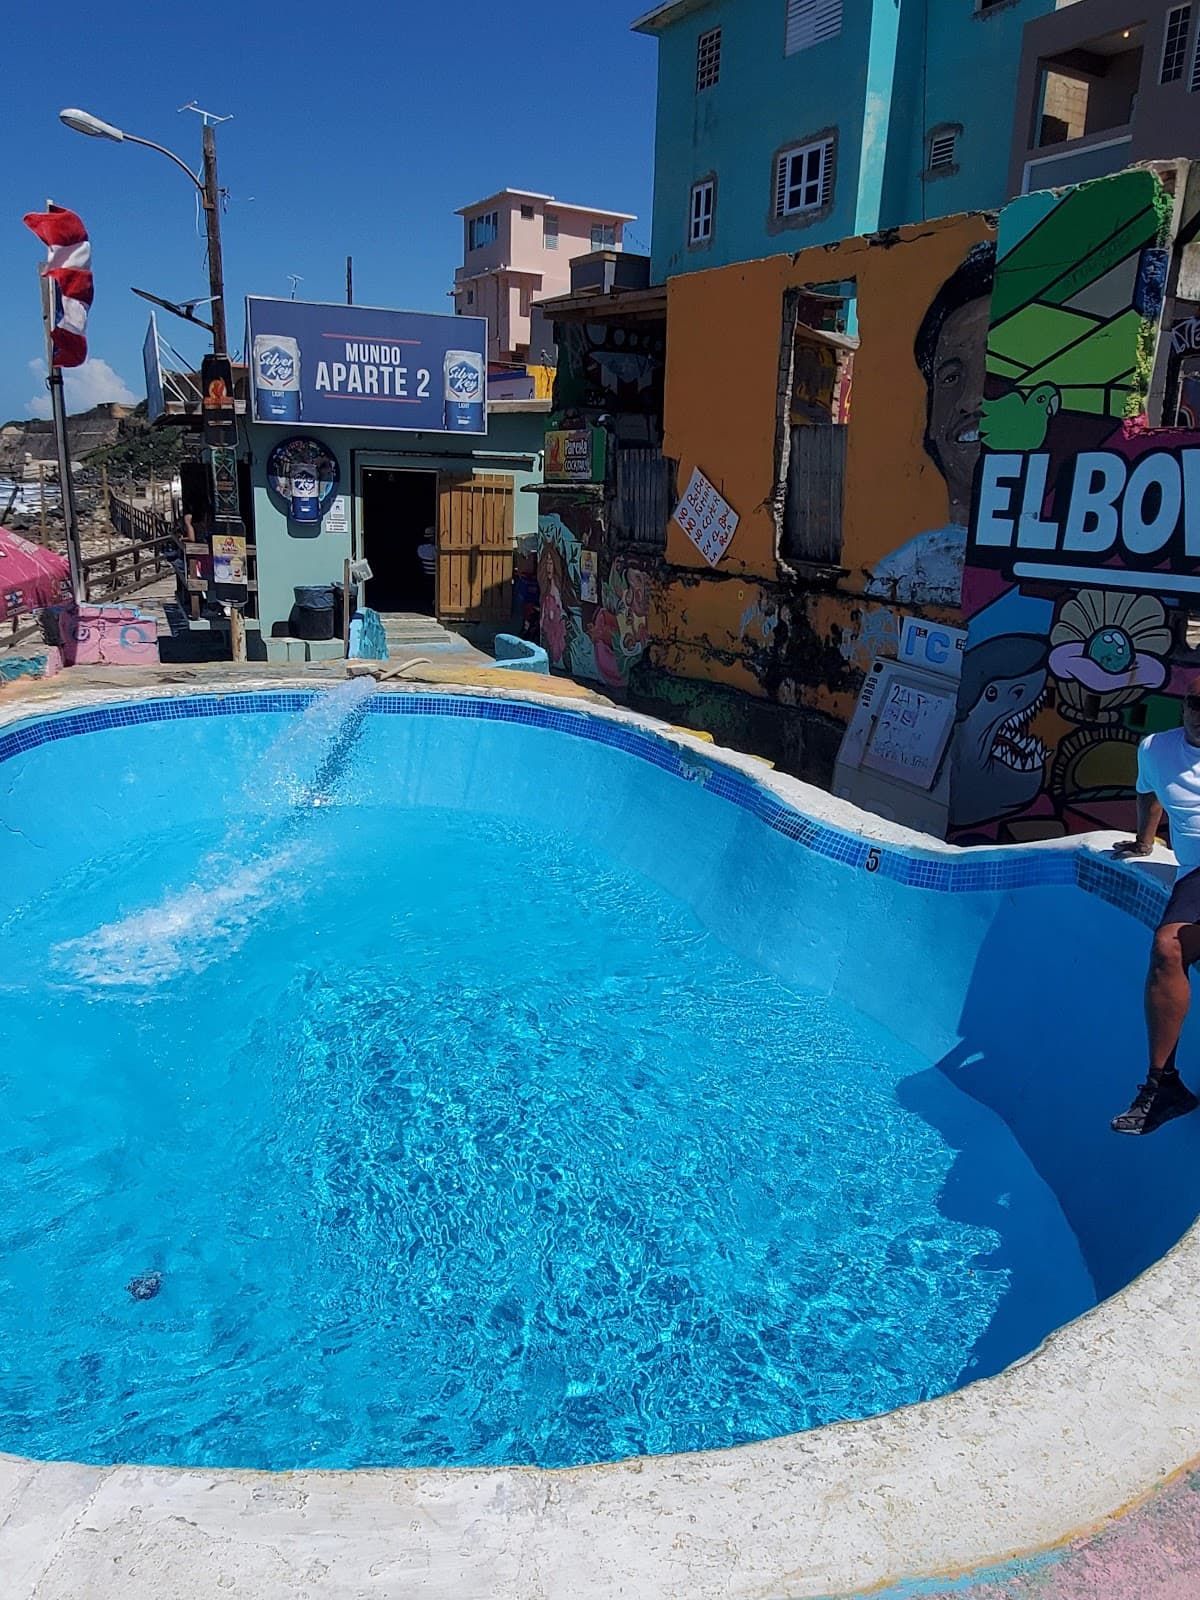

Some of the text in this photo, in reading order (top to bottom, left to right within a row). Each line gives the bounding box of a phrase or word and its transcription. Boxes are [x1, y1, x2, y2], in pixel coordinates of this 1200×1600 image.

[260, 351, 293, 366] Silver
[346, 342, 400, 365] MUNDO
[266, 364, 292, 379] Key
[315, 361, 430, 398] APARTE 2
[449, 366, 478, 380] Silver
[454, 378, 478, 392] Key
[678, 507, 688, 524] NO
[694, 495, 720, 544] NO COMER
[684, 517, 696, 535] NO
[702, 540, 711, 555] EN
[865, 847, 882, 872] 5
